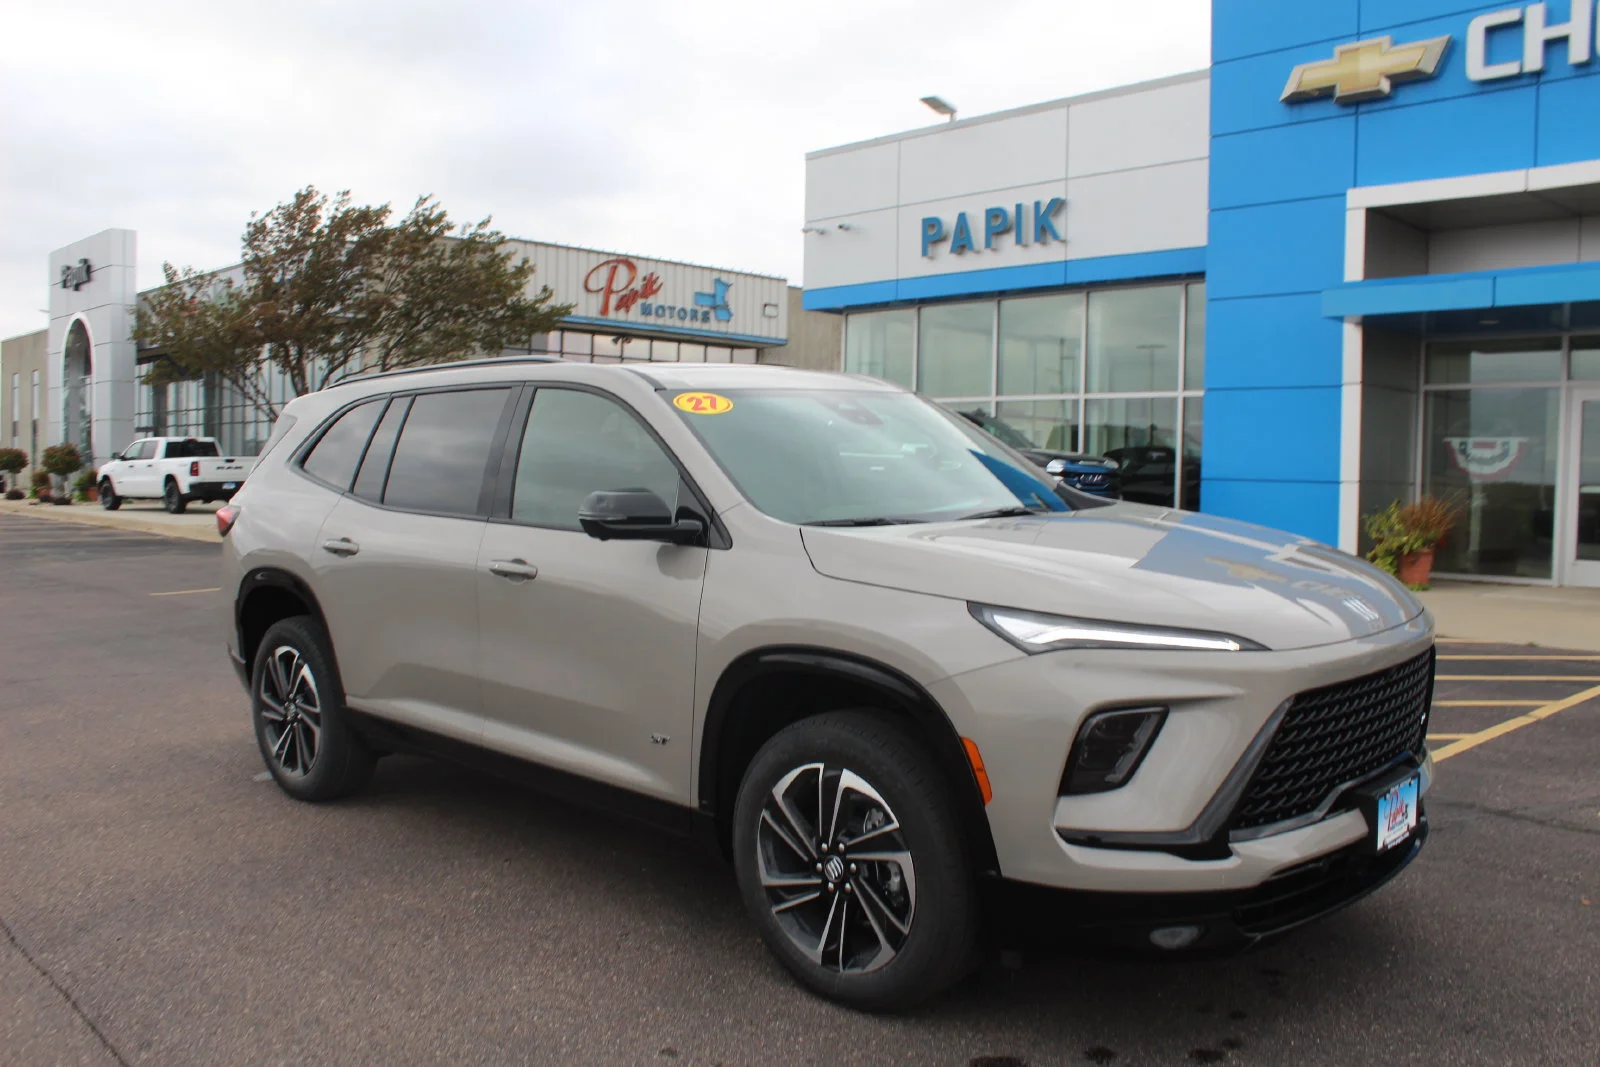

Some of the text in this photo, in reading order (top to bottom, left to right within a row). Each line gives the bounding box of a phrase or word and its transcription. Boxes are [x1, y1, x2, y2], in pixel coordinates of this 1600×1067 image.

[1465, 0, 1600, 82] CH
[920, 196, 1066, 258] PAPIK
[640, 302, 711, 324] MOTORS
